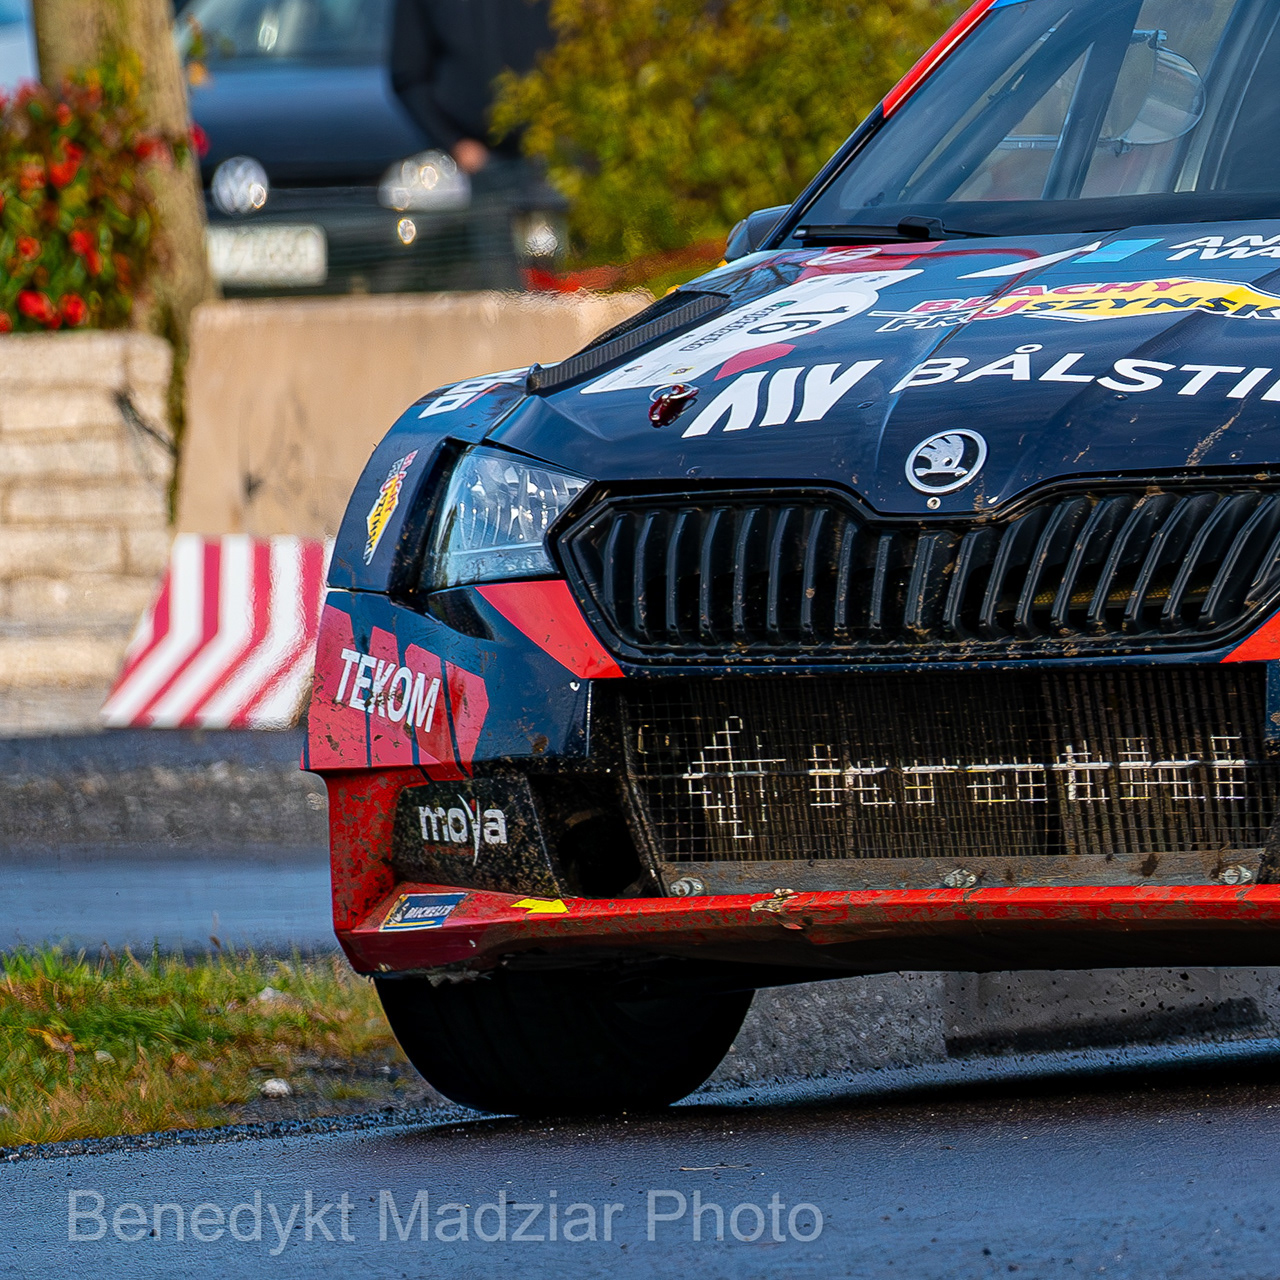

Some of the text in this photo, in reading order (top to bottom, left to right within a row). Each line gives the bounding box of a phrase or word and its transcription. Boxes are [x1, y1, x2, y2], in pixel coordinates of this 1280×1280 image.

[911, 278, 1200, 314] BLACHY
[334, 648, 441, 733] TEKOM
[418, 793, 508, 867] moya
